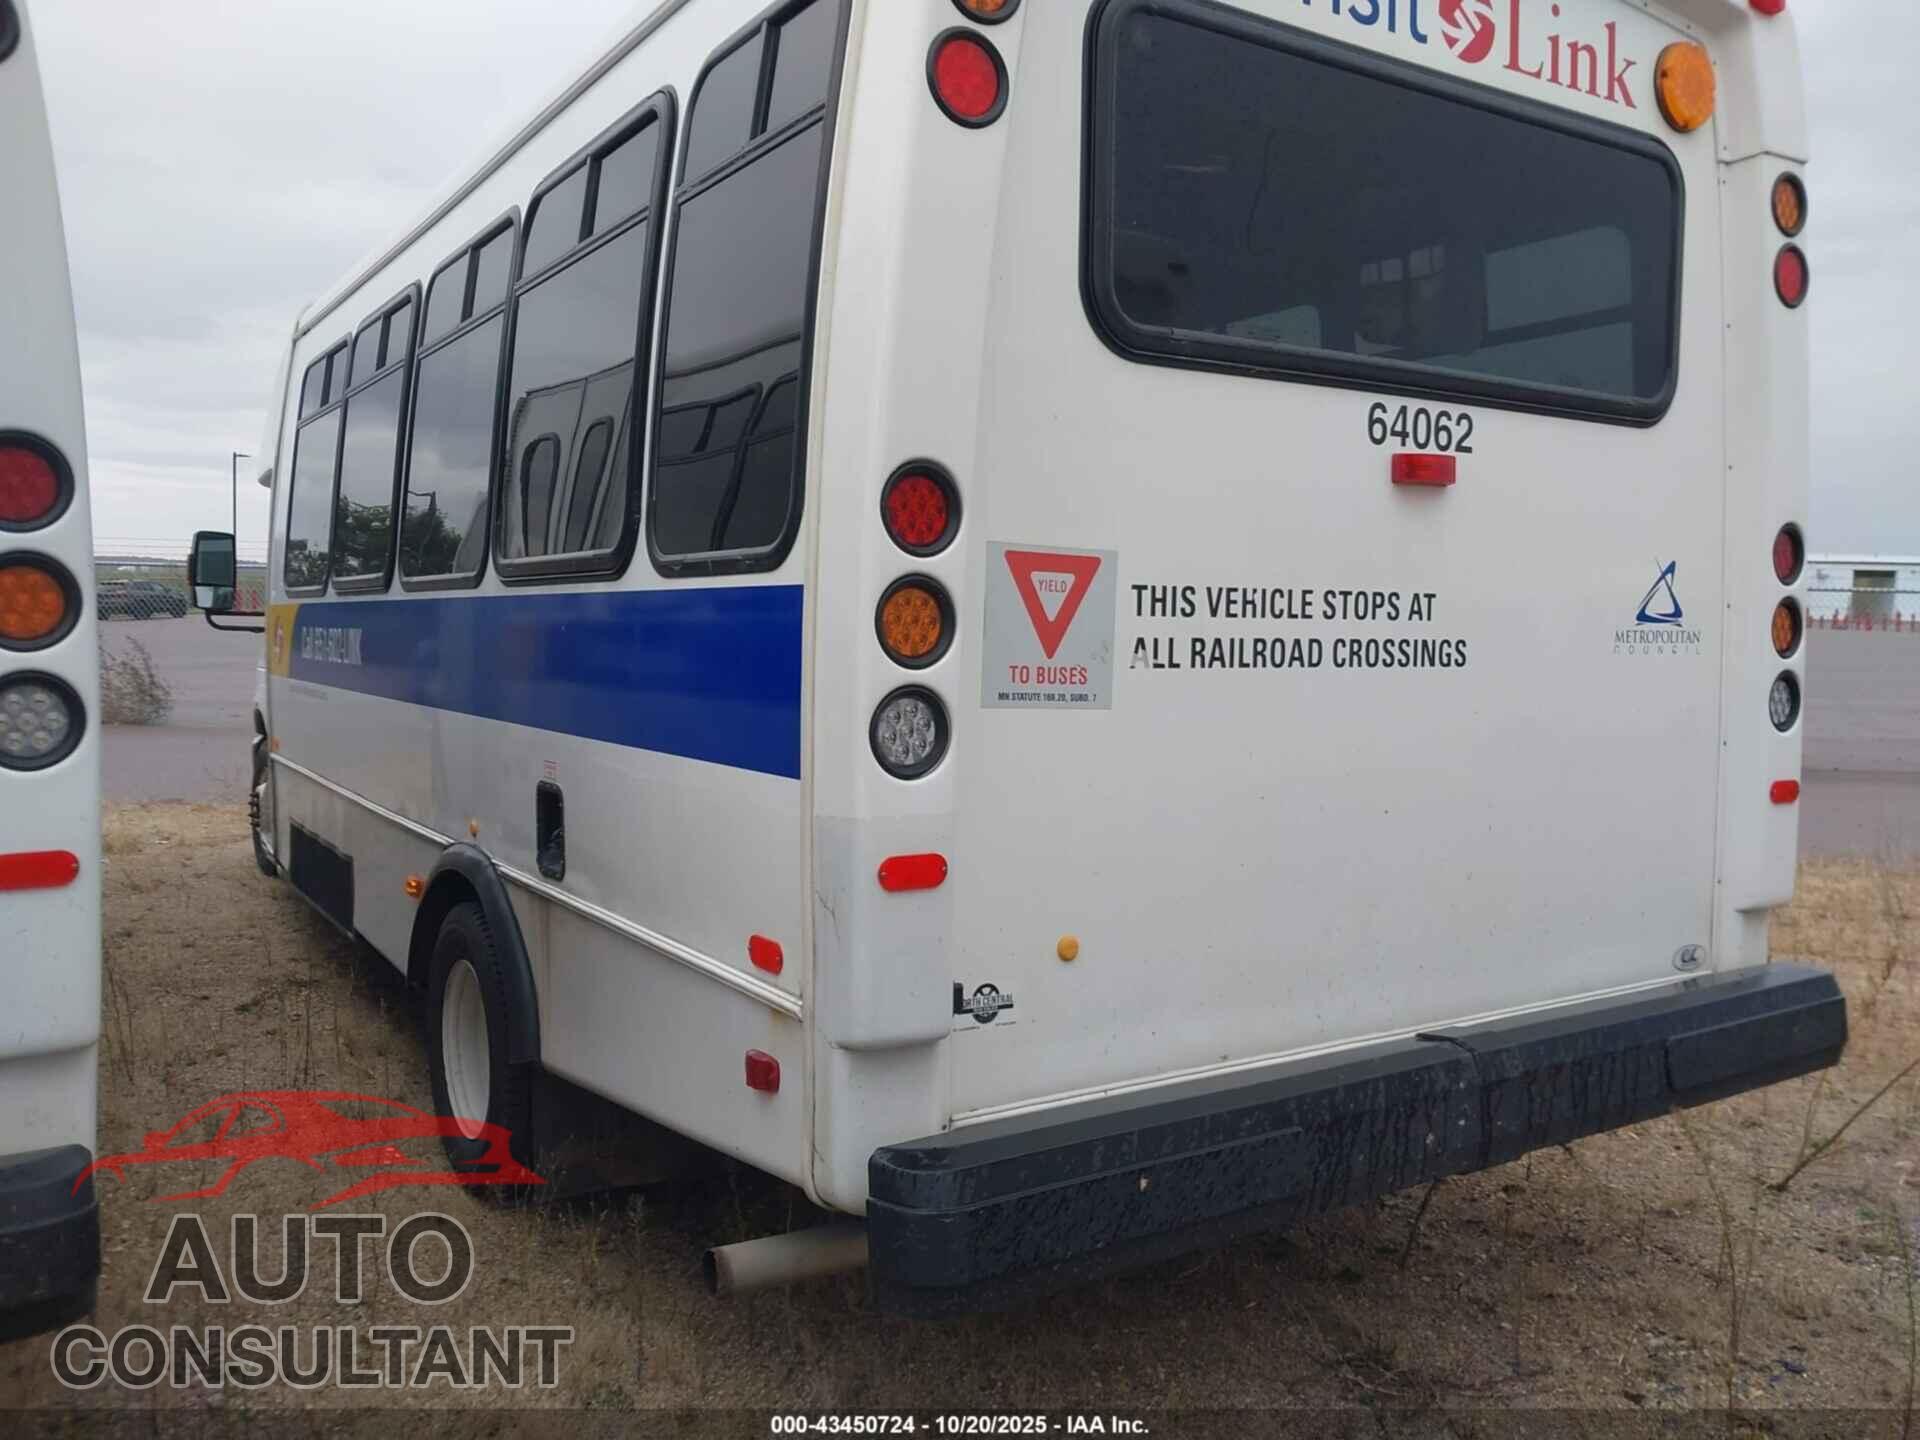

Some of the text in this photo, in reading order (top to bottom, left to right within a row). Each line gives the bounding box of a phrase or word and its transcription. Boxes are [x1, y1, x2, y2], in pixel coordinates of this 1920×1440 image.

[1503, 0, 1637, 109] Link
[1367, 401, 1474, 454] 64062
[1038, 579, 1067, 593] YIELD
[1131, 585, 1436, 621] THIS VEHICLE STOPS AT
[1614, 644, 1701, 655] COUNCIL
[1615, 630, 1701, 644] METROPOLITAN
[1129, 637, 1467, 669] ALL RAILROAD CROSSINGS
[1009, 664, 1088, 685] TO BUSES
